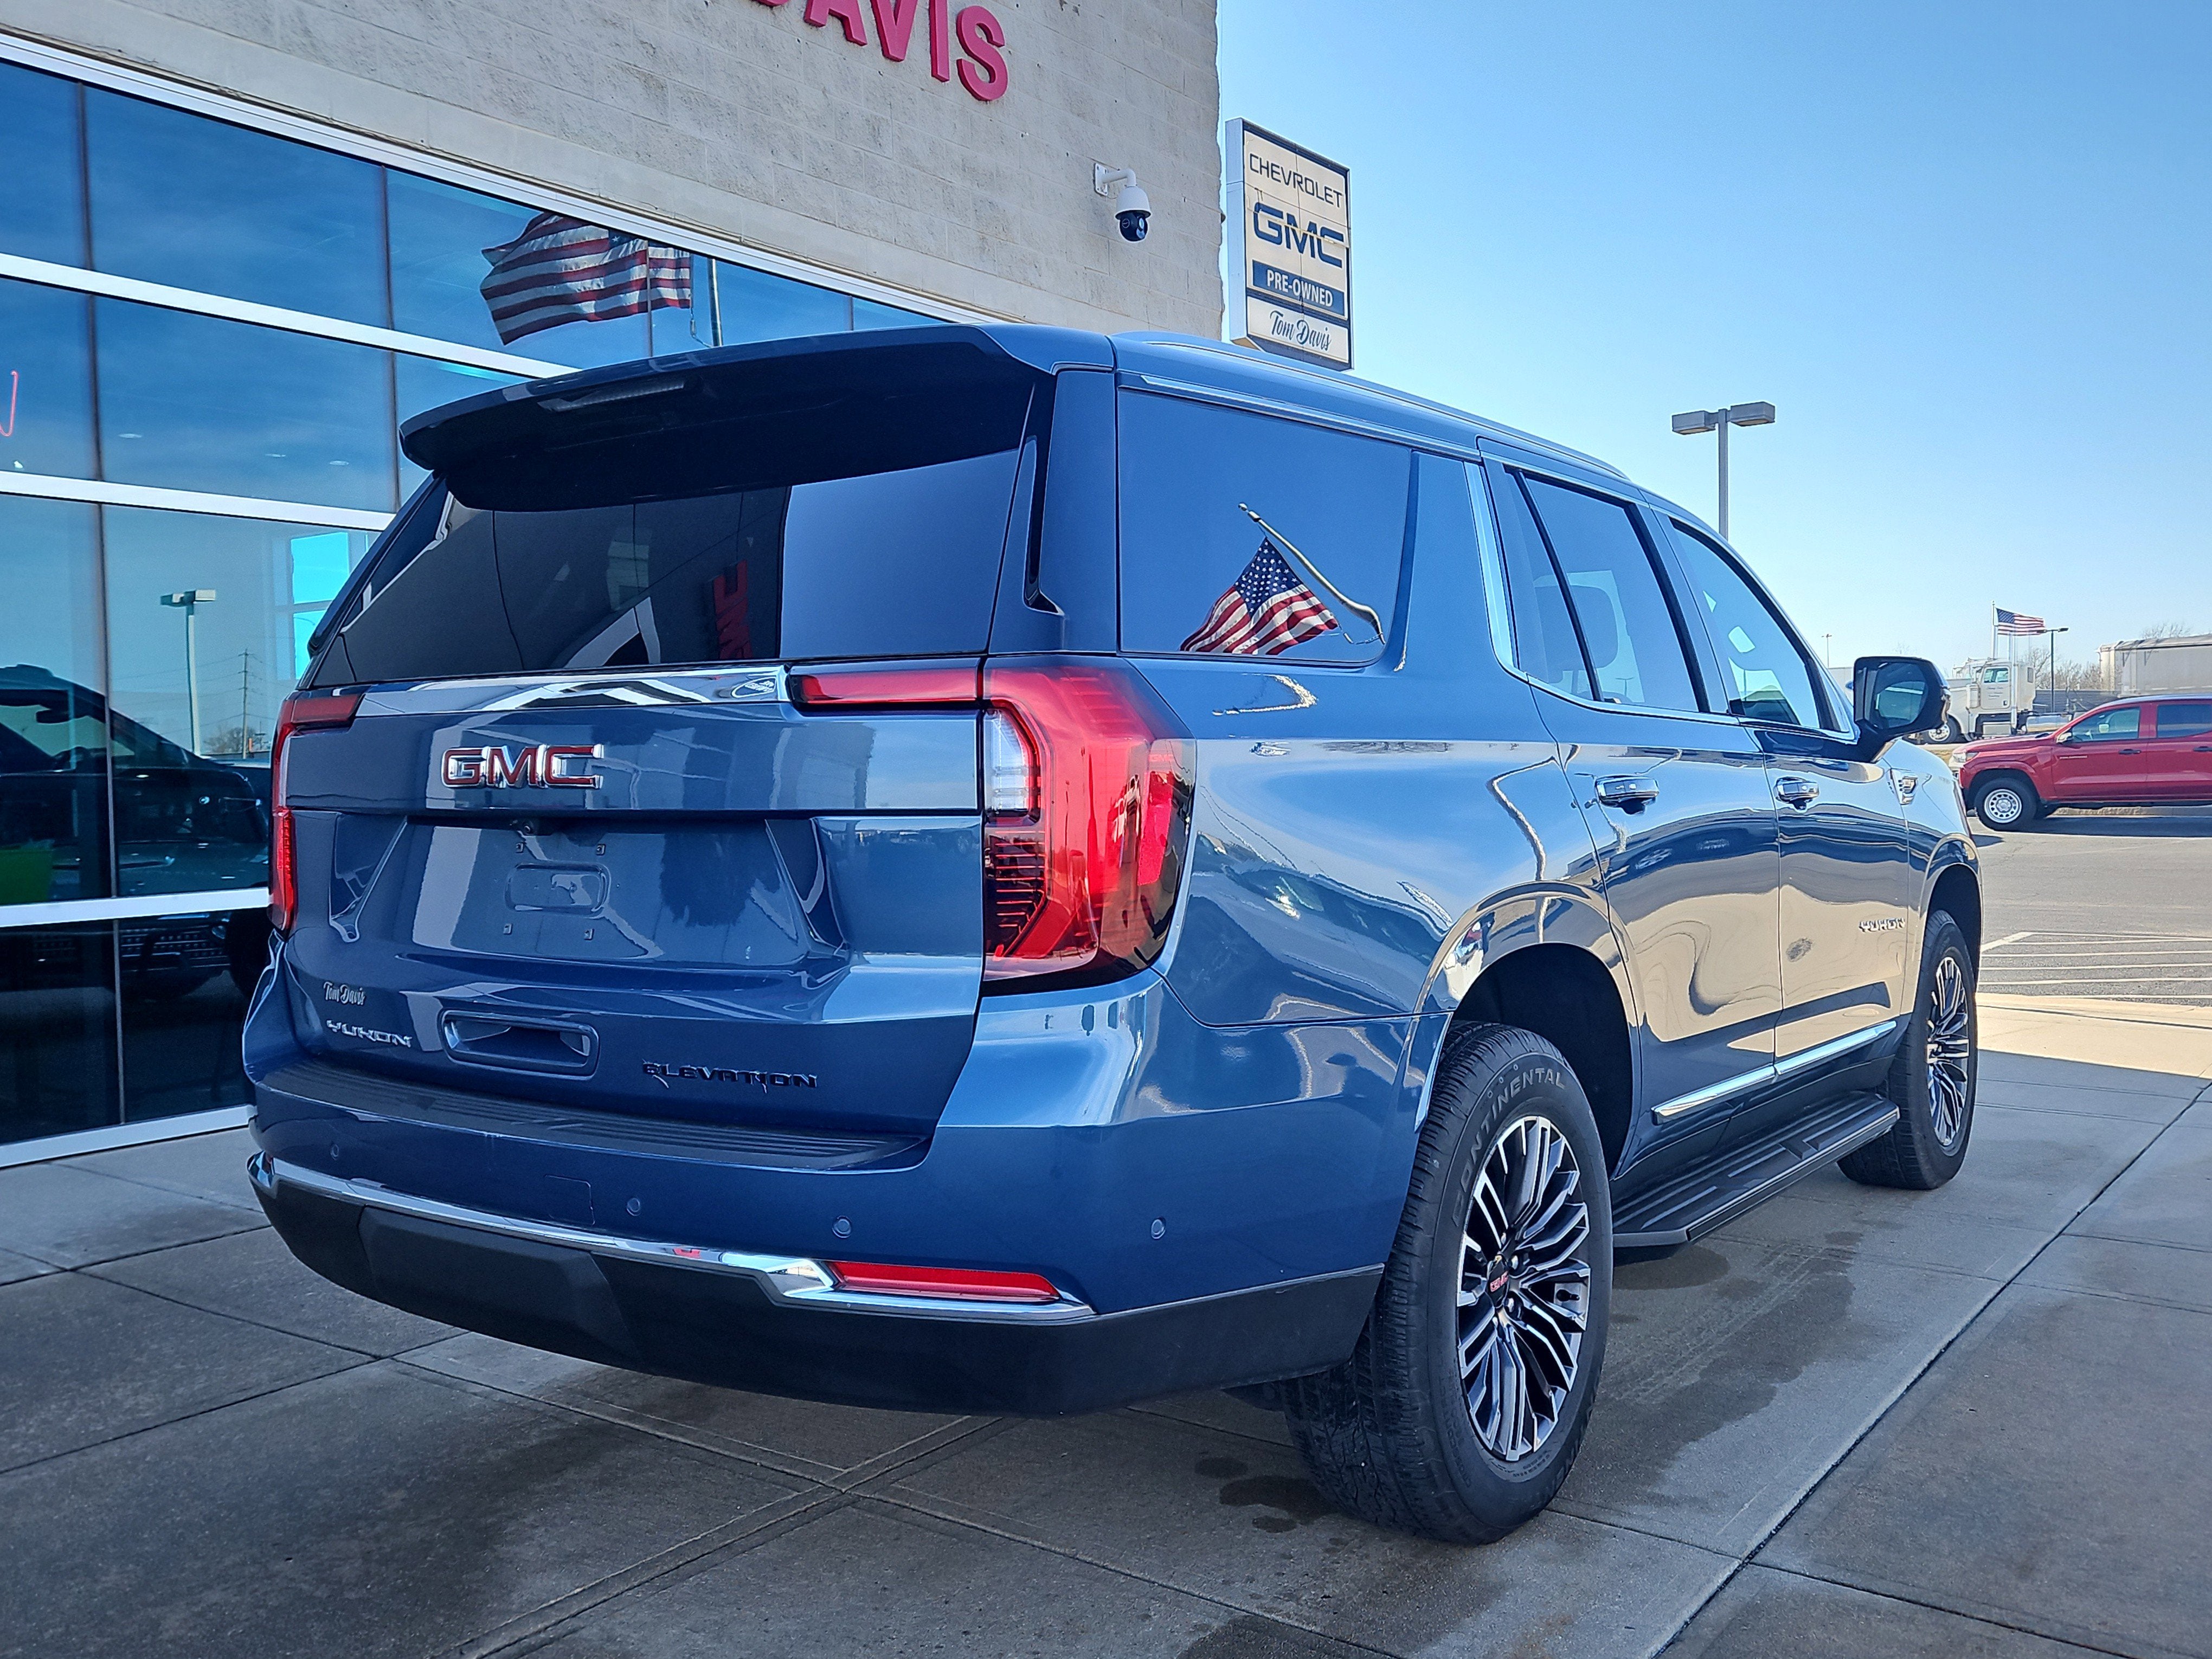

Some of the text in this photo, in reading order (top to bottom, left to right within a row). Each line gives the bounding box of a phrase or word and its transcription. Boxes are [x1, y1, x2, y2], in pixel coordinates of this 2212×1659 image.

[749, 0, 1008, 101] VIS
[1250, 153, 1343, 208] CHEVROLET
[1253, 201, 1345, 268] GMC
[1266, 269, 1333, 307] PRE-OWNED
[1270, 310, 1332, 351] Tom Davis
[441, 743, 604, 789] GMC
[1859, 917, 1906, 933] YUKON
[323, 981, 366, 1006] Tom Davis
[326, 1019, 413, 1048] YUKON
[642, 1061, 818, 1089] ELEVATION
[1451, 1067, 1566, 1227] CONTINENTAL
